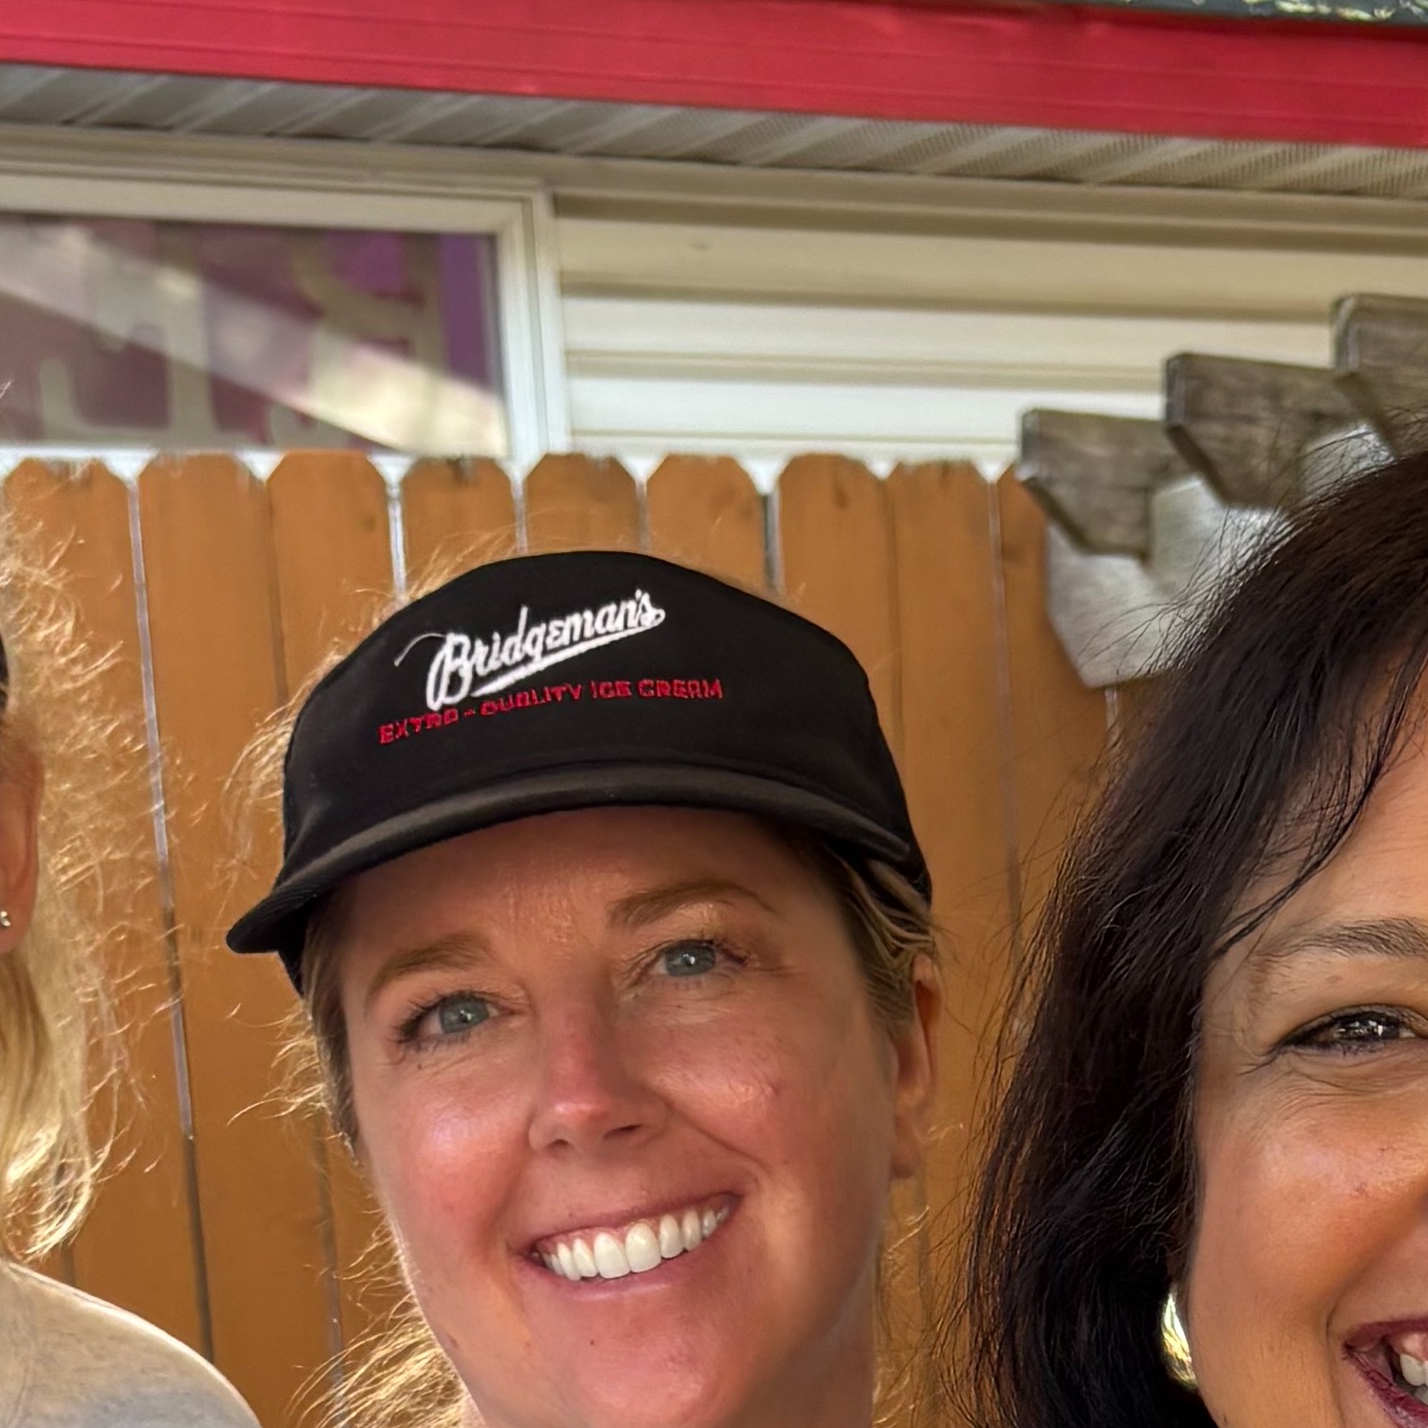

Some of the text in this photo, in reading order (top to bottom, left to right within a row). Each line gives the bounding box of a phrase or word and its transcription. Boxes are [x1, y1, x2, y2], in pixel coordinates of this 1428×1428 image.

[426, 588, 665, 711] Bridgeman's
[590, 680, 632, 699] ICE
[638, 679, 723, 699] CREAM
